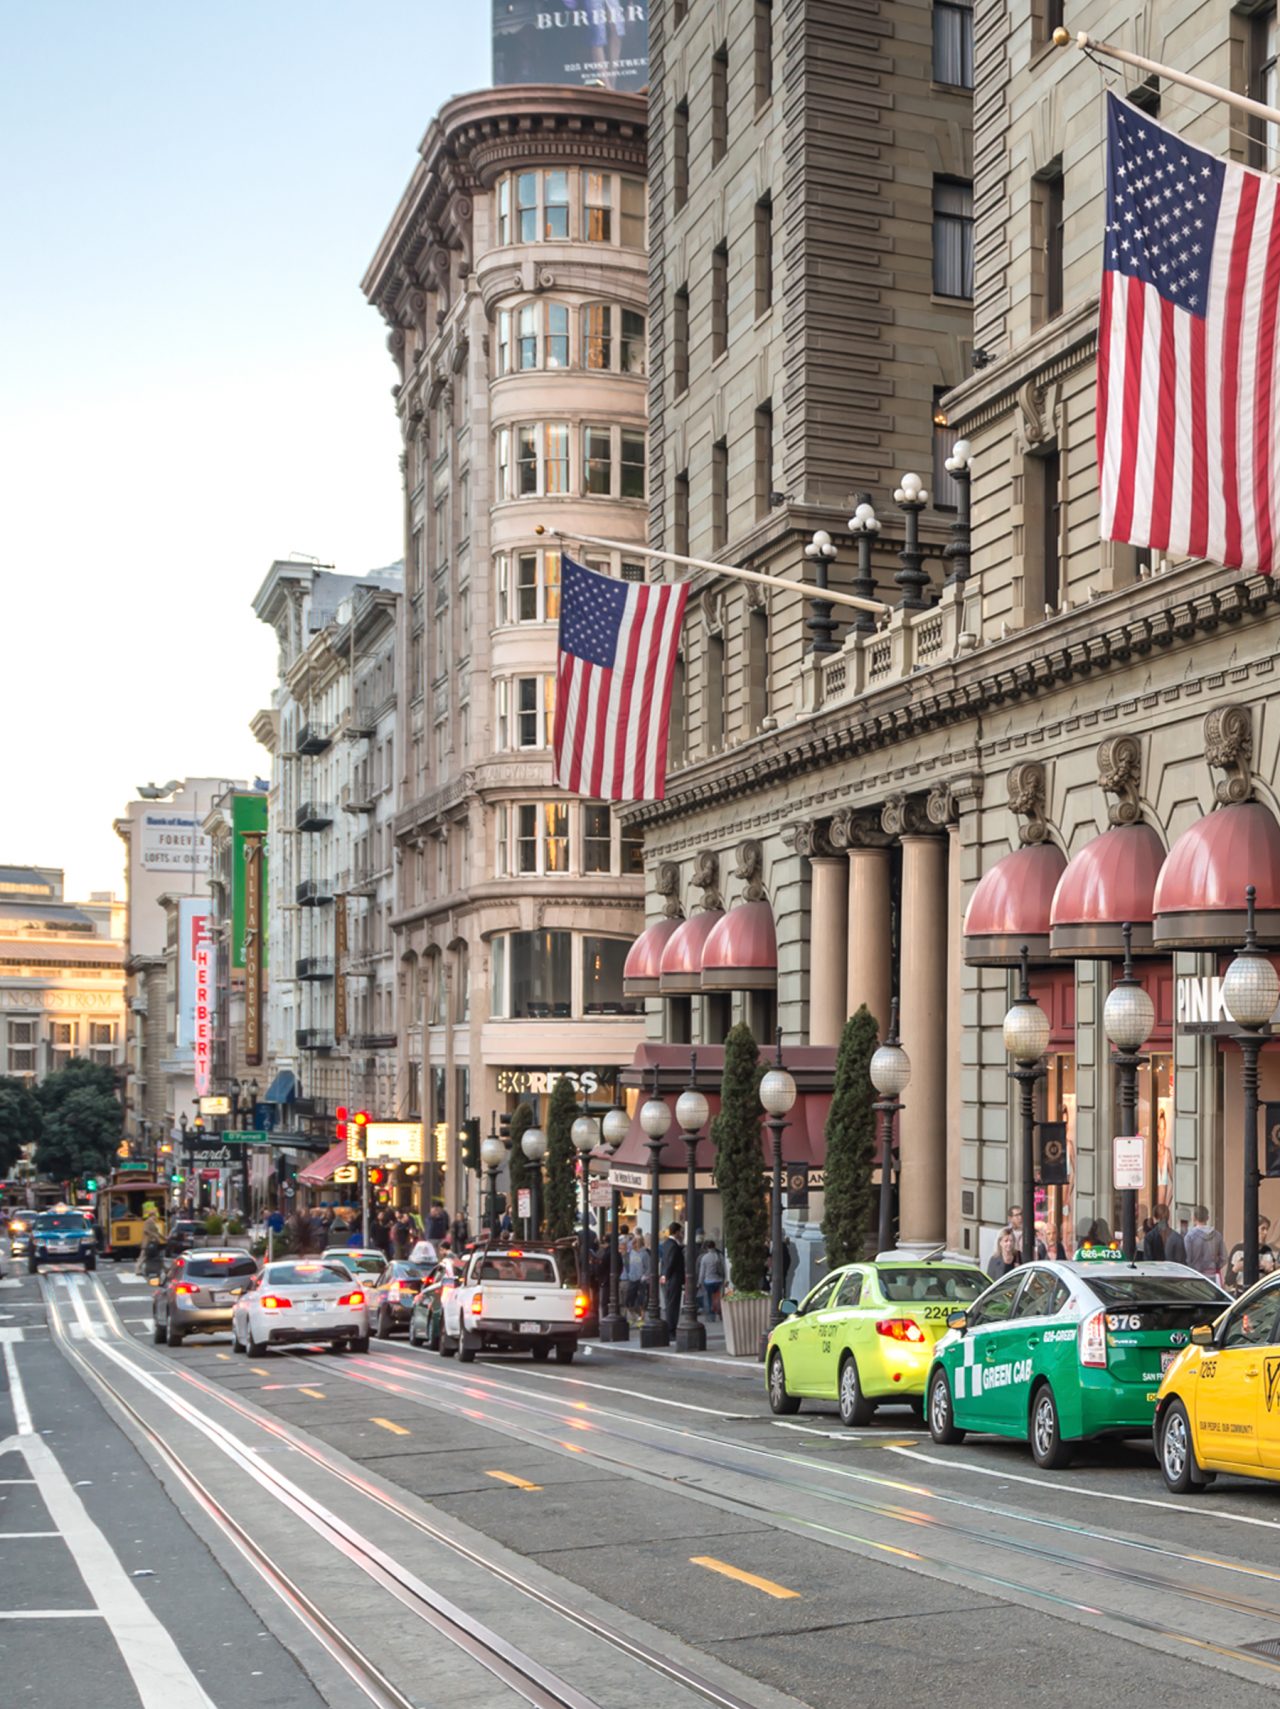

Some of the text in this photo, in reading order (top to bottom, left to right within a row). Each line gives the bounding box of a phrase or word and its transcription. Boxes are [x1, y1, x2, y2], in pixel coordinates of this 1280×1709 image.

[536, 5, 645, 30] BURBER
[584, 61, 610, 71] POST
[613, 58, 648, 68] STREE
[146, 817, 167, 826] Bank
[168, 817, 176, 826] of
[159, 834, 205, 846] FOREVER
[144, 852, 170, 864] LOFTS
[183, 854, 200, 864] ONE
[244, 928, 258, 1048] FLORENCE
[8, 991, 112, 1007] NORDSTROM
[1177, 976, 1236, 1023] PINK
[197, 952, 208, 1073] HERBERT
[498, 1072, 598, 1094] EXPRESS
[1080, 1250, 1122, 1259] 626-4733
[1108, 1314, 1141, 1330] 376
[983, 1359, 1033, 1390] GREEN CAB
[1142, 1373, 1156, 1381] SAN
[1200, 1360, 1217, 1379] 1265
